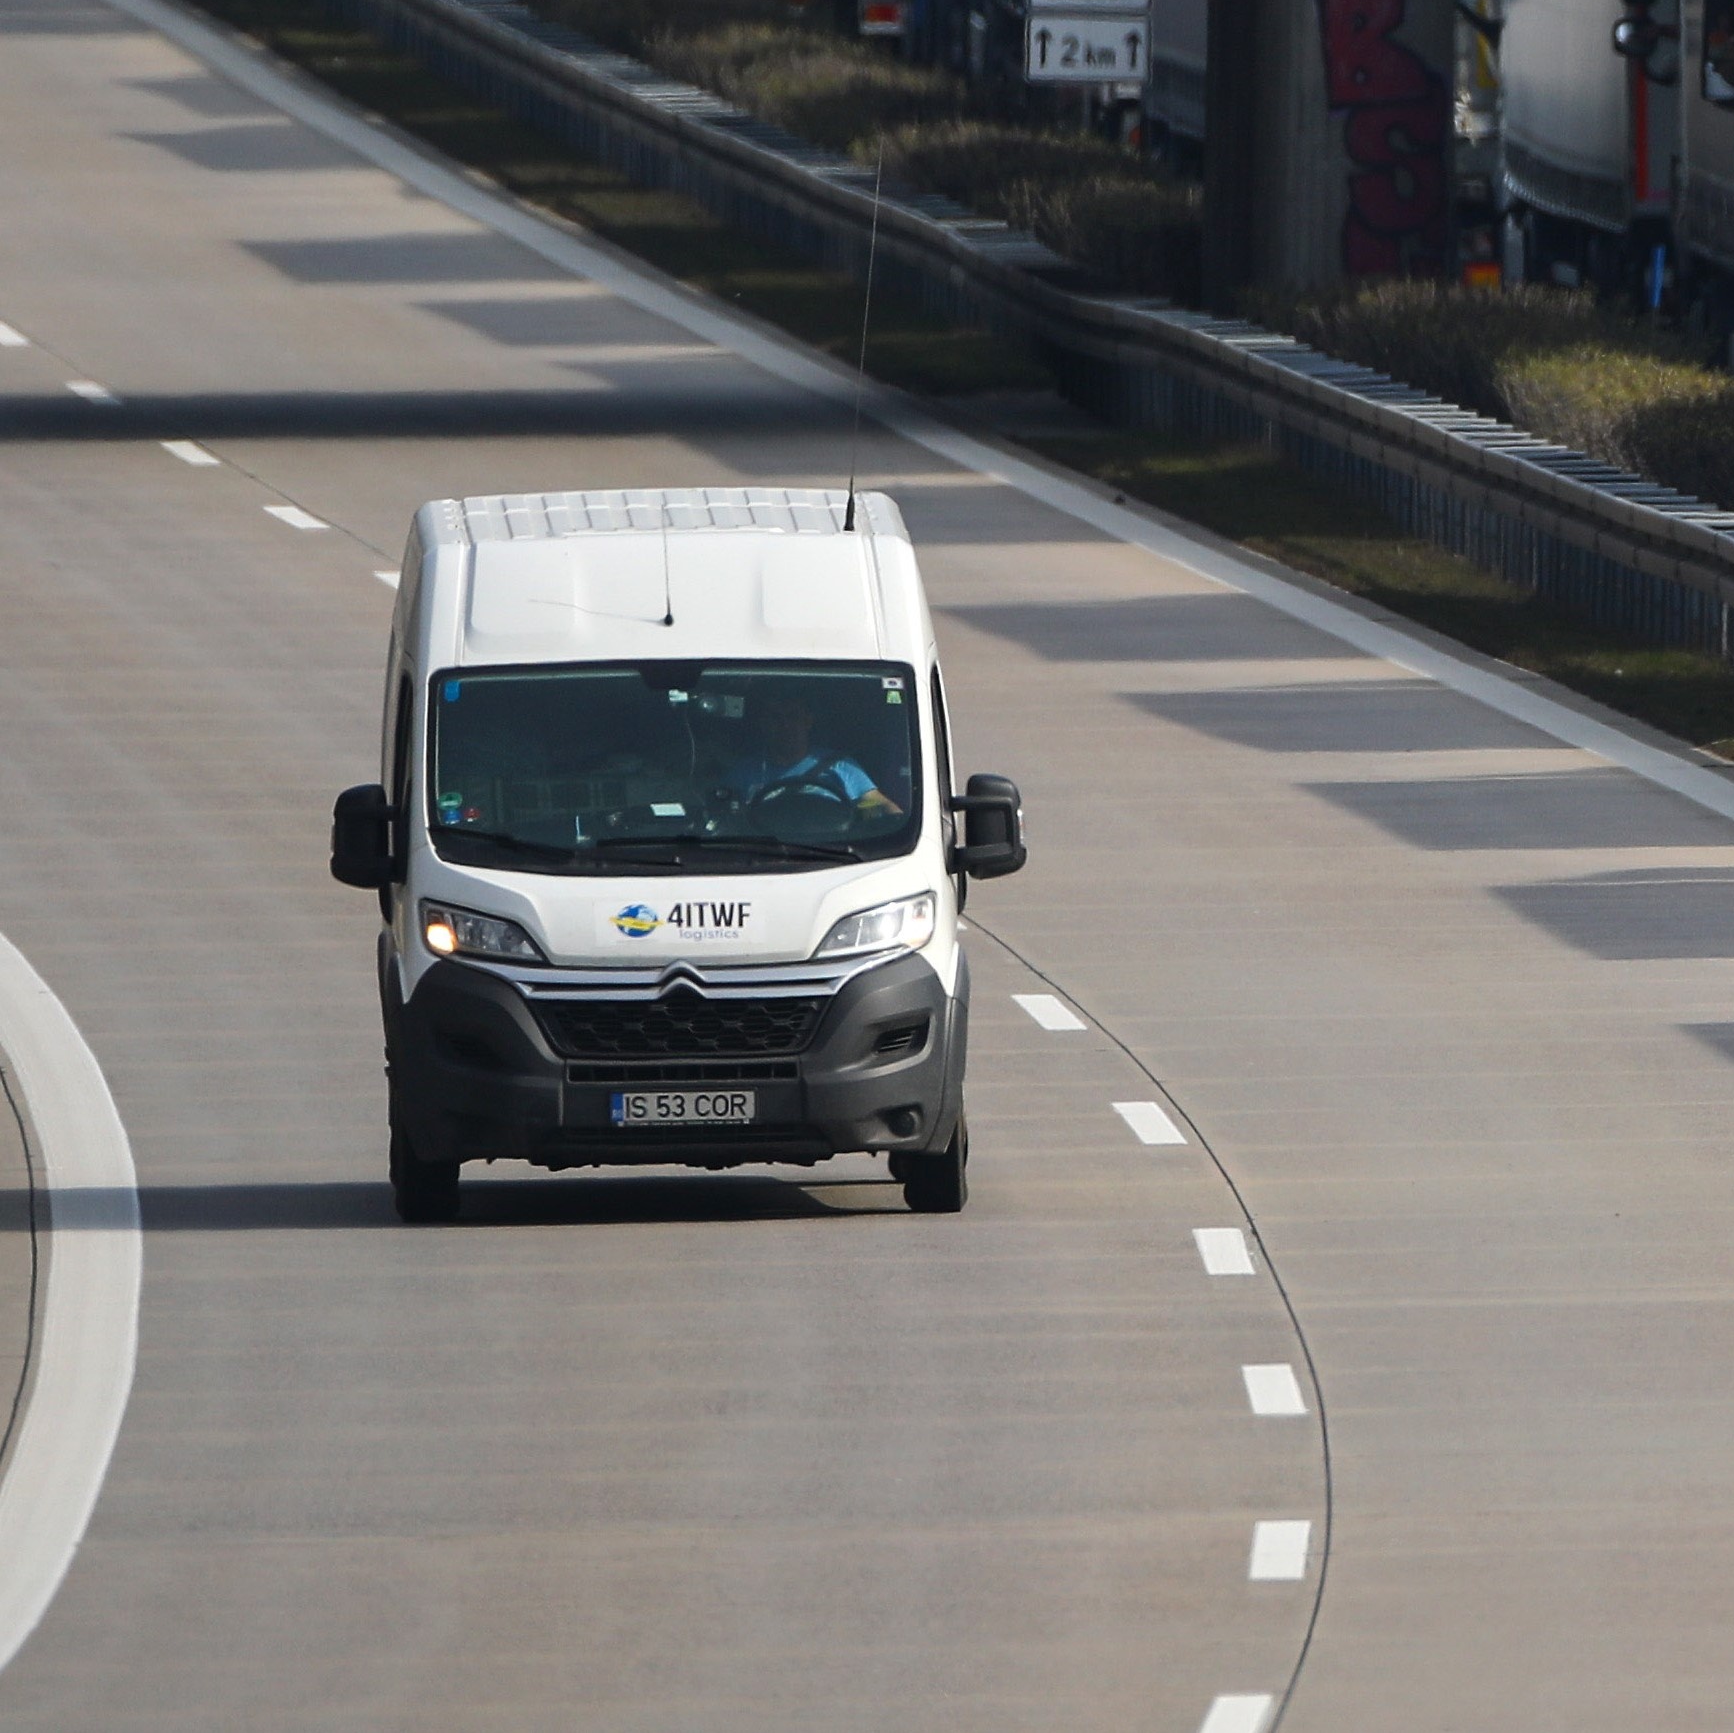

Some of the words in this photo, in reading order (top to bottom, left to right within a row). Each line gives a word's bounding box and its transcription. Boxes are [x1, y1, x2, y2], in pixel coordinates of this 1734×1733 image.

[1060, 33, 1081, 68] 2
[1084, 41, 1117, 68] km
[667, 901, 752, 929] 4ITWF
[679, 929, 739, 942] logistics
[624, 1095, 647, 1119] IS
[656, 1094, 686, 1118] 53
[694, 1093, 748, 1117] COR
